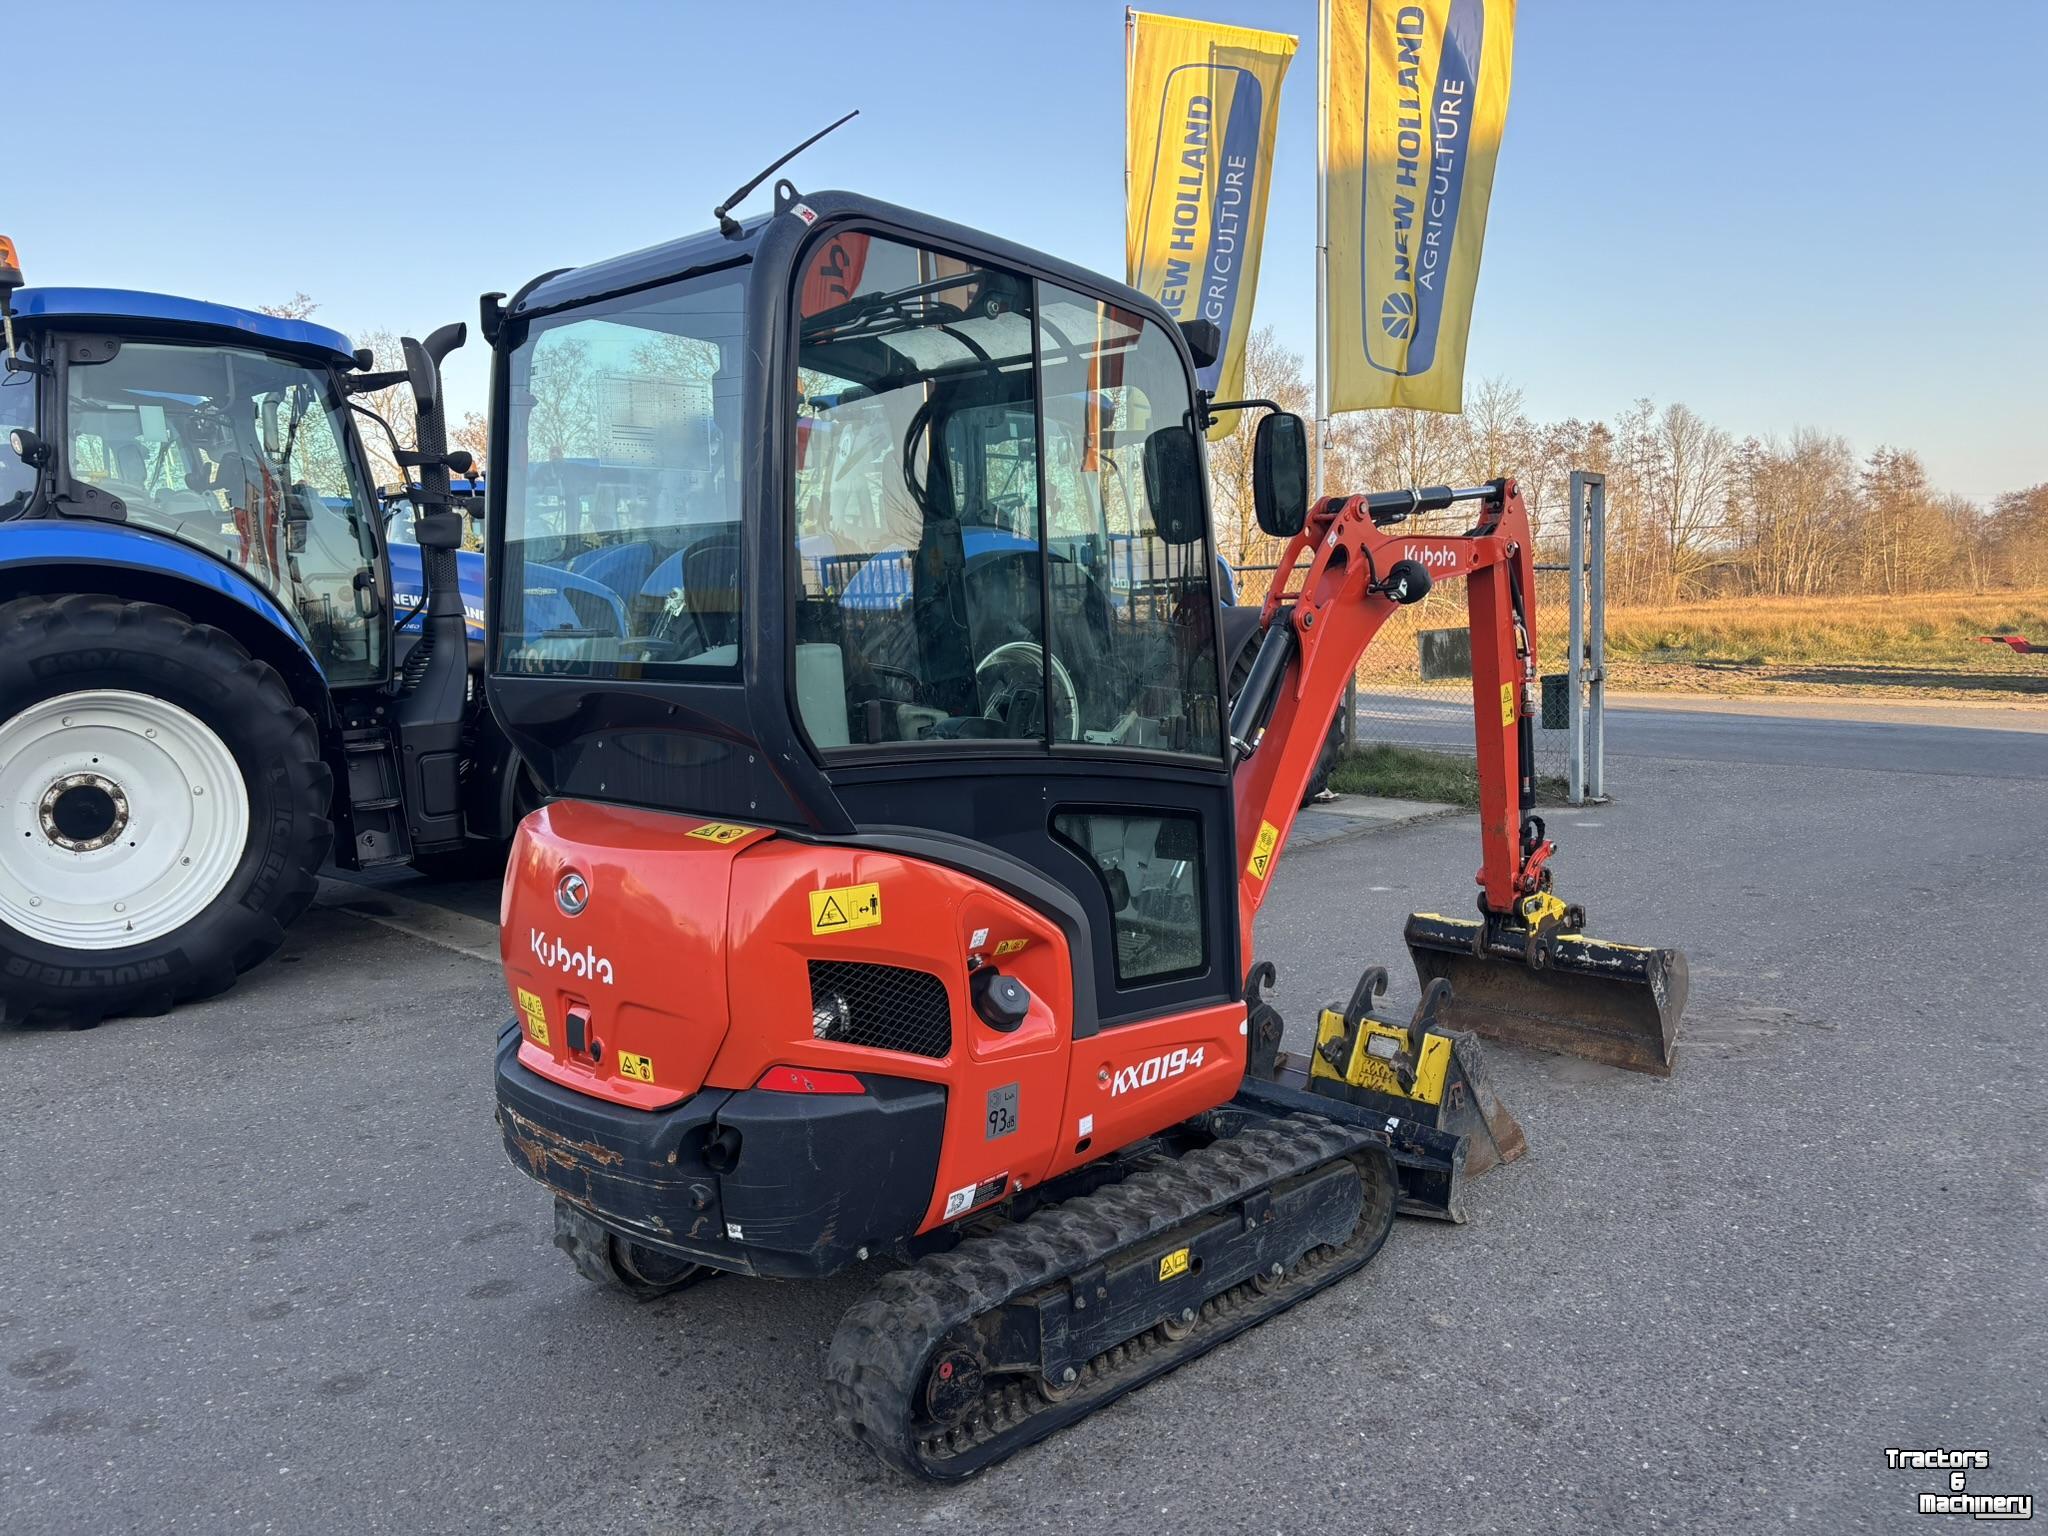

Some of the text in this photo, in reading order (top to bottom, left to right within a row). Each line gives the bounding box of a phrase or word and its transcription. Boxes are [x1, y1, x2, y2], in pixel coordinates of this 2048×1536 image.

[1170, 95, 1212, 251] HOLLAND
[1394, 6, 1425, 282] NEW HOLLAND
[1419, 79, 1464, 291] AGRICULTURE
[1204, 155, 1246, 325] GRICULTURE
[393, 592, 421, 607] NEW
[1404, 544, 1457, 567] Kubota
[531, 927, 614, 985] Kubota
[1111, 1046, 1204, 1098] KX019-4
